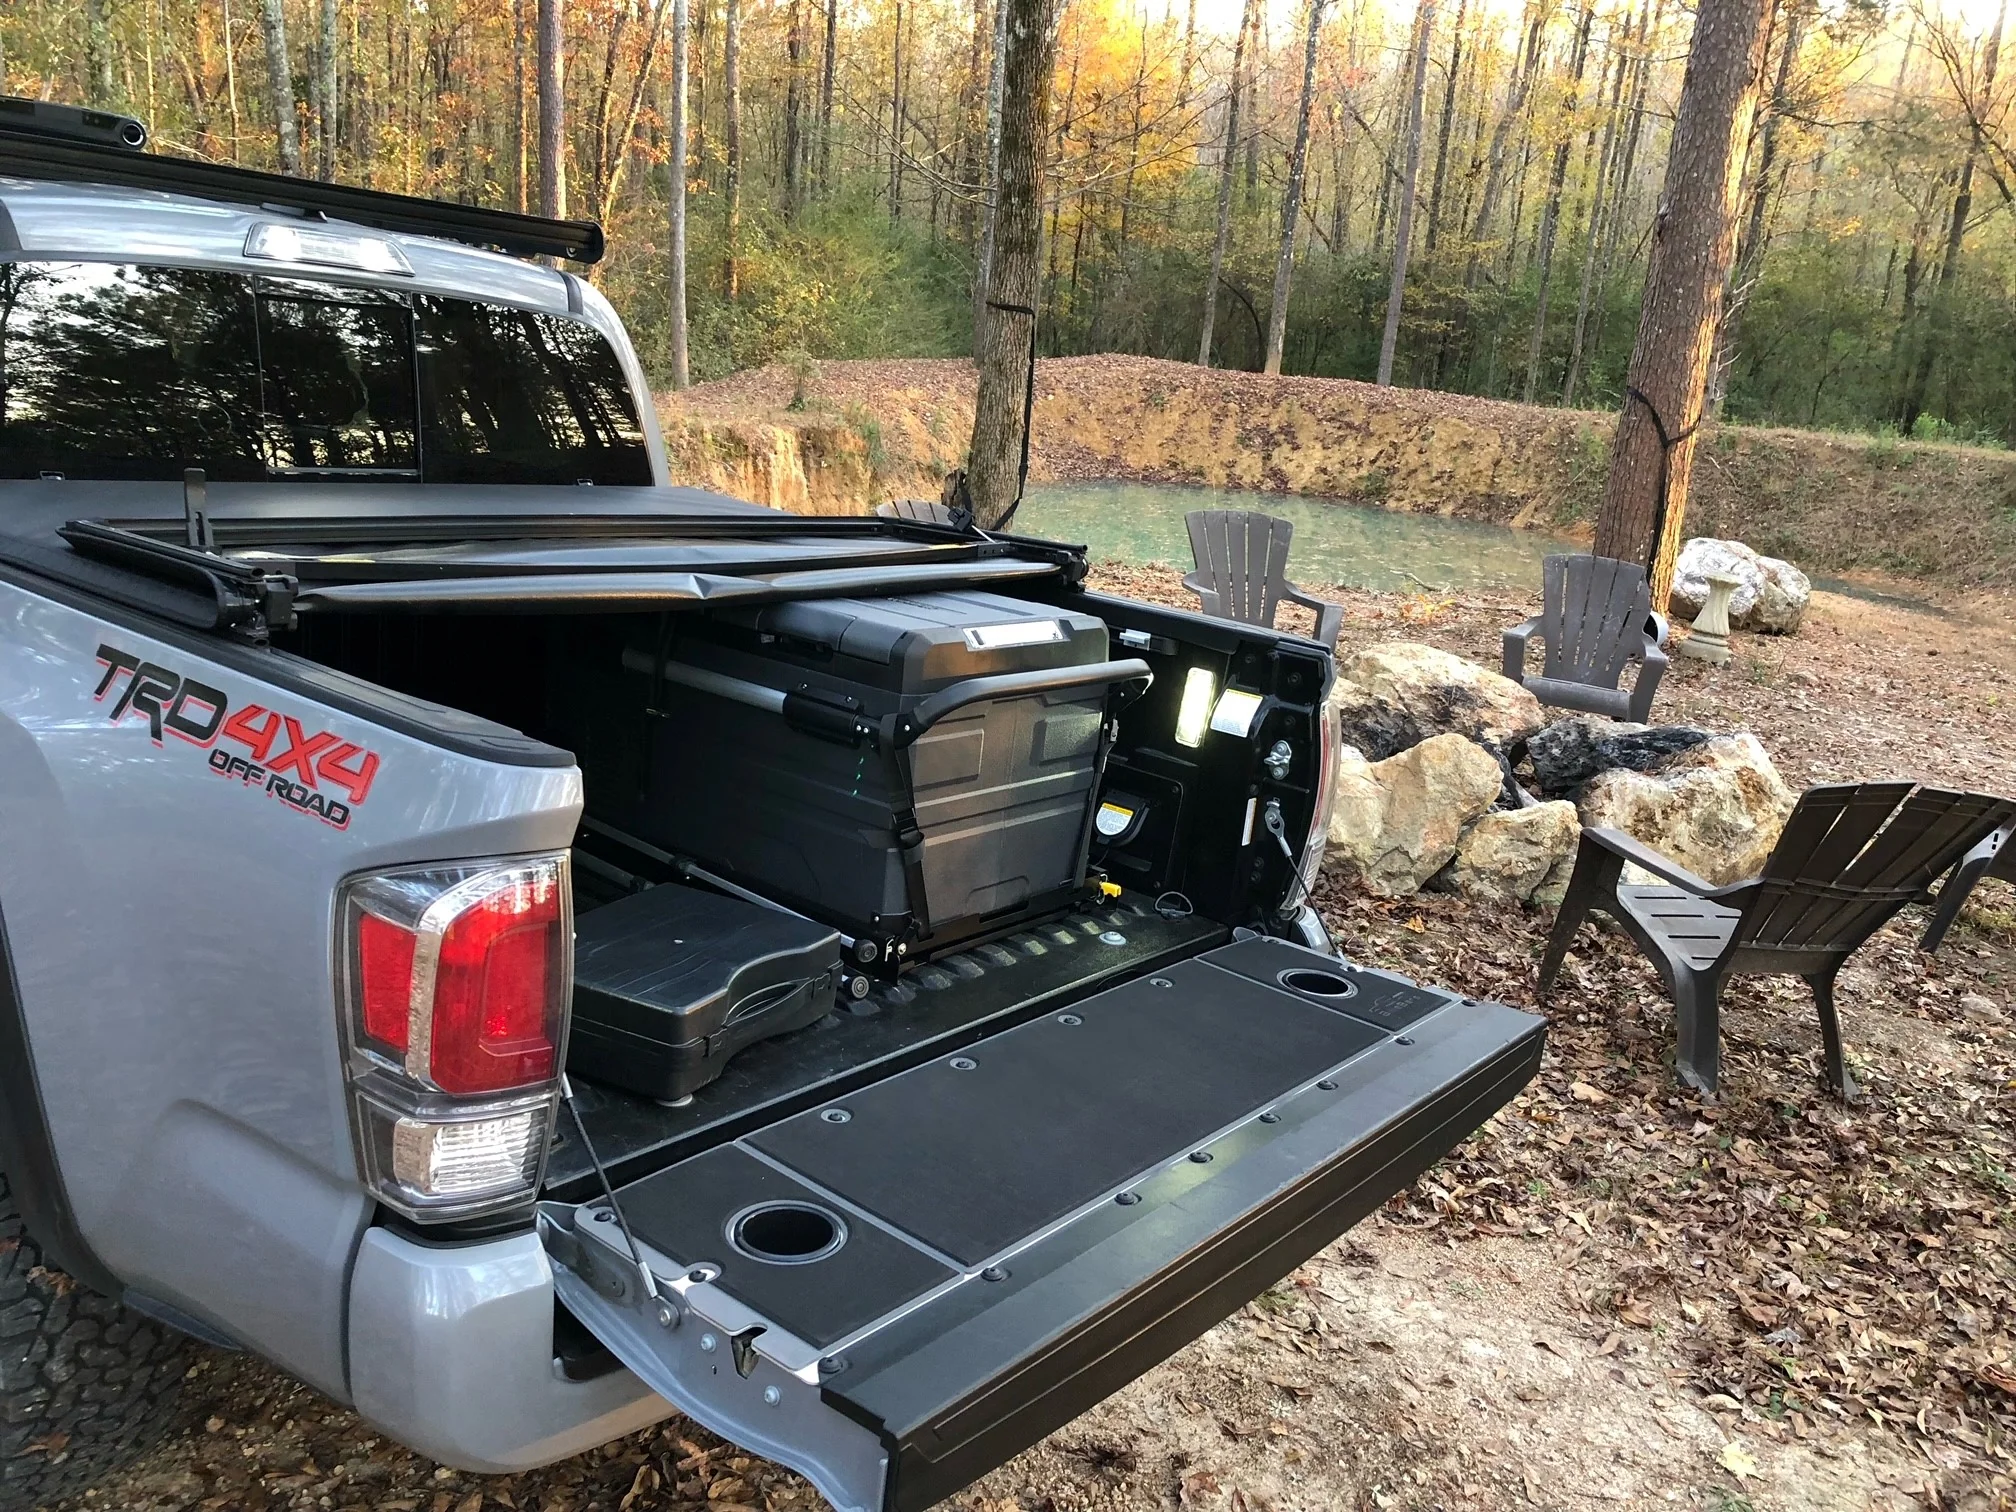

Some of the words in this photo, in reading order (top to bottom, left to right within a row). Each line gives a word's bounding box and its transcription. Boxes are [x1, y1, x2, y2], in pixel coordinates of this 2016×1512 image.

[93, 643, 228, 748] TRD
[221, 703, 380, 805] 4X4
[208, 748, 266, 787] OFF
[265, 773, 351, 831] ROAD
